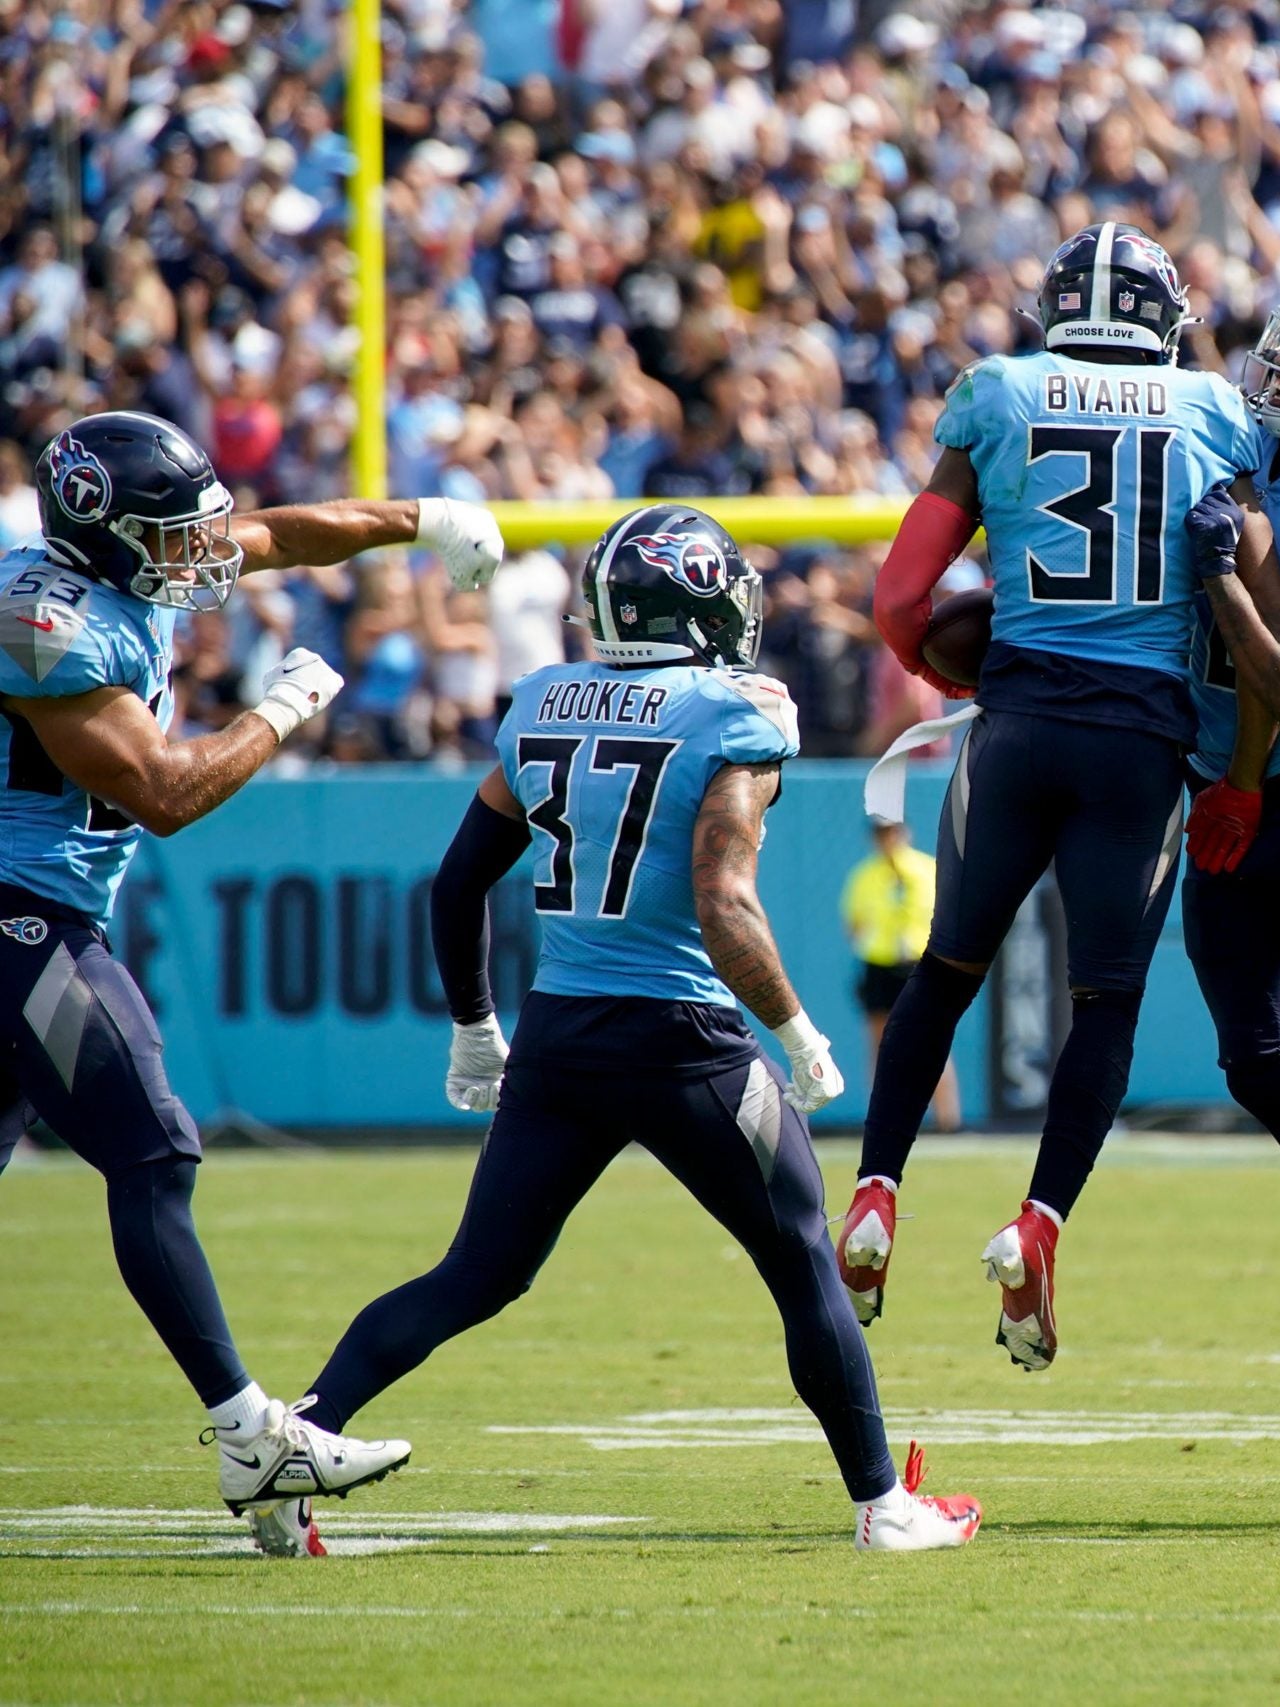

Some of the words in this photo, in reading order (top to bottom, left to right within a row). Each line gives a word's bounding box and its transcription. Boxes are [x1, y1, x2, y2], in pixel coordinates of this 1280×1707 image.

[1065, 327, 1104, 337] CHOOSE
[1107, 328, 1135, 339] LOVE
[1046, 373, 1169, 418] BYARD
[1026, 425, 1177, 606] 31
[537, 680, 668, 727] HOOKER
[517, 734, 682, 920] 37
[277, 1470, 310, 1479] ALPHA
